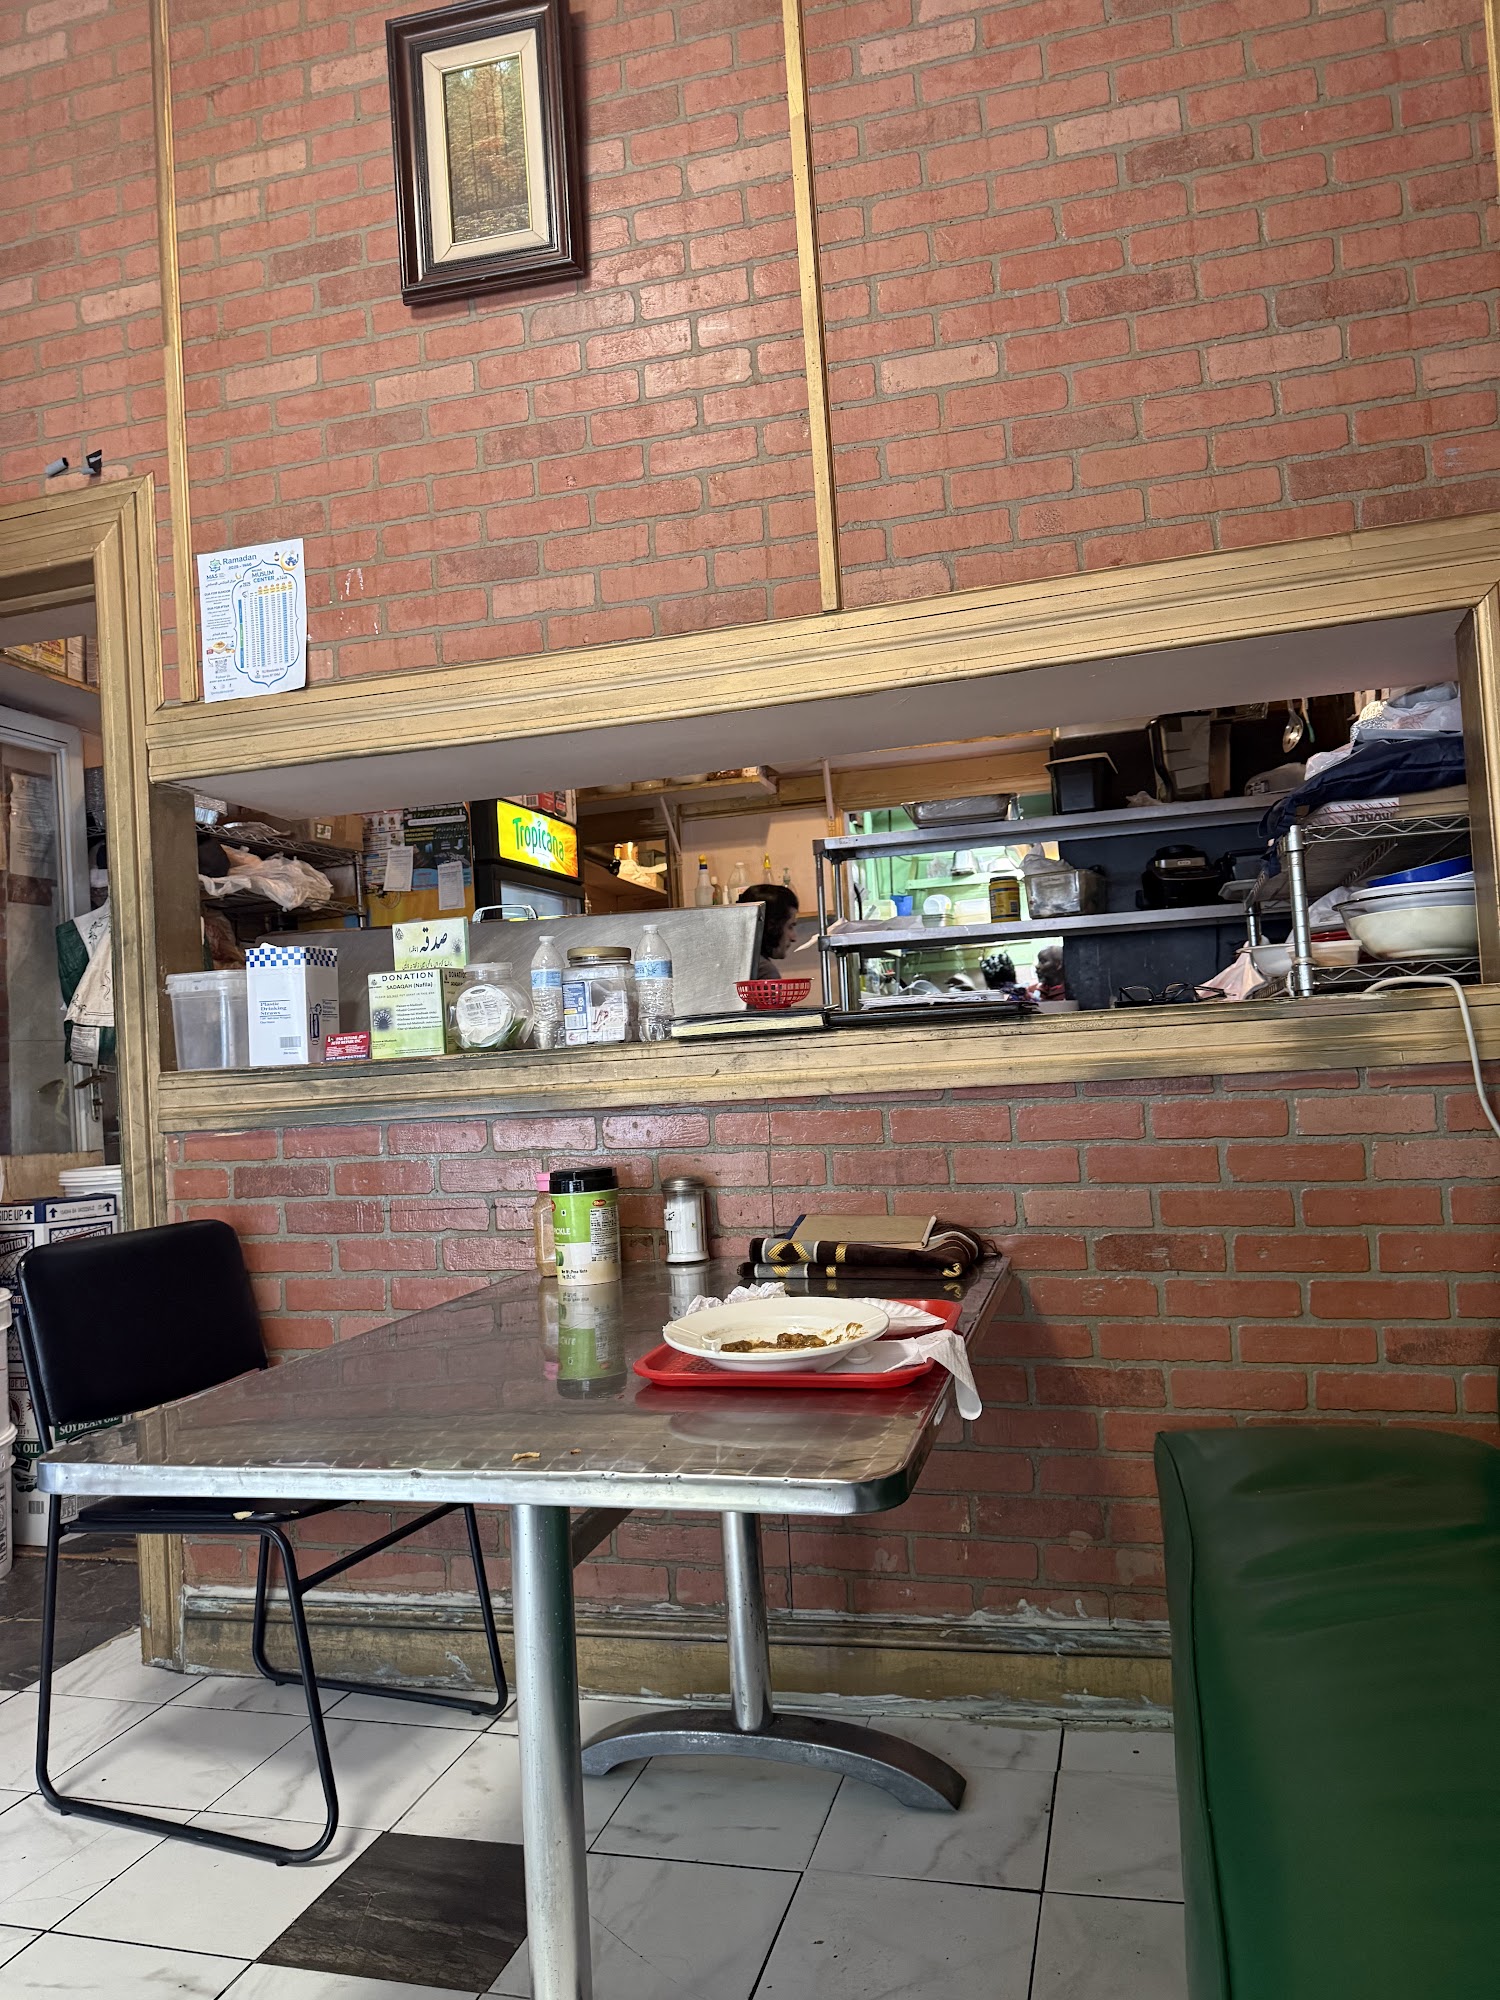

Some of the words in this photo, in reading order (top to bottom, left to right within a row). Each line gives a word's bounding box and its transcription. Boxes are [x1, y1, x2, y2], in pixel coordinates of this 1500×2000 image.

[222, 554, 257, 565] Ramadan
[252, 570, 274, 578] MUSLIM
[512, 817, 564, 862] Tropicana
[381, 971, 434, 982] DONATION
[413, 981, 433, 989] (Nafila)
[14, 1209, 24, 1221] UP
[553, 1227, 571, 1235] ICKLE
[22, 1443, 40, 1454] OIL
